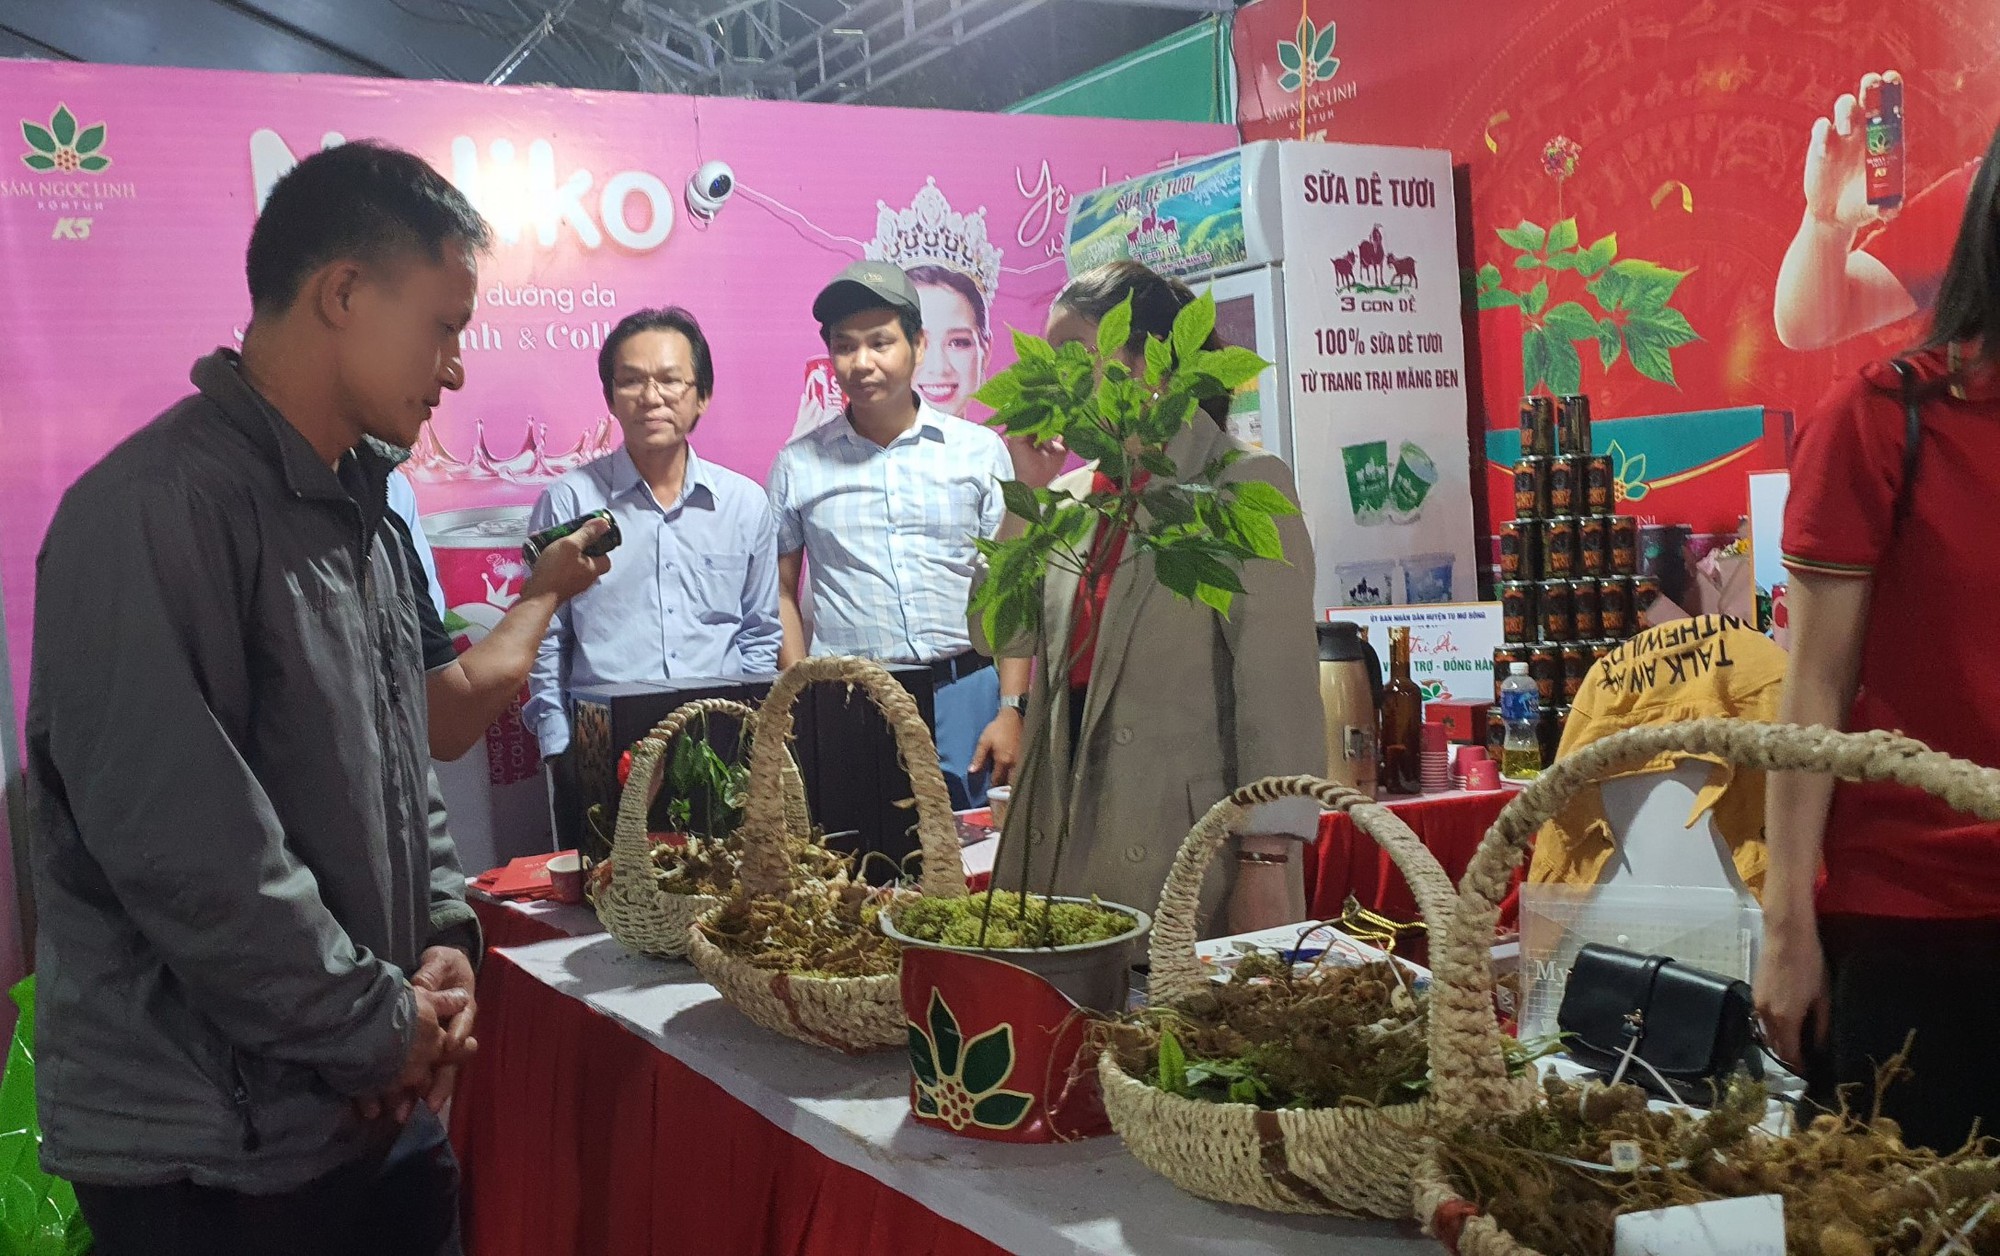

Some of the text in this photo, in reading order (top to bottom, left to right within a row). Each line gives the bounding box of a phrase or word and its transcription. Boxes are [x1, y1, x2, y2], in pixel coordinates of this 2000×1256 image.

[1289, 109, 1335, 130] KTUM
[94, 181, 136, 198] LINH
[1304, 169, 1435, 208] SỮA DÊ TƯƠI
[1016, 159, 1074, 247] Yê
[51, 217, 93, 240] K5
[581, 282, 616, 308] da
[1341, 294, 1416, 313] 3 CON DÊ
[458, 321, 612, 351] nh & Coll
[1314, 327, 1443, 355] 100% SỮA DÊ TƯƠI
[1301, 366, 1459, 395] TỪ TRANG TRẠI MĂNG ĐEN
[1414, 659, 1434, 674] TRỢ
[1475, 656, 1494, 671] HÀN
[1663, 639, 1733, 685] TALK
[508, 694, 524, 768] COLLAGE
